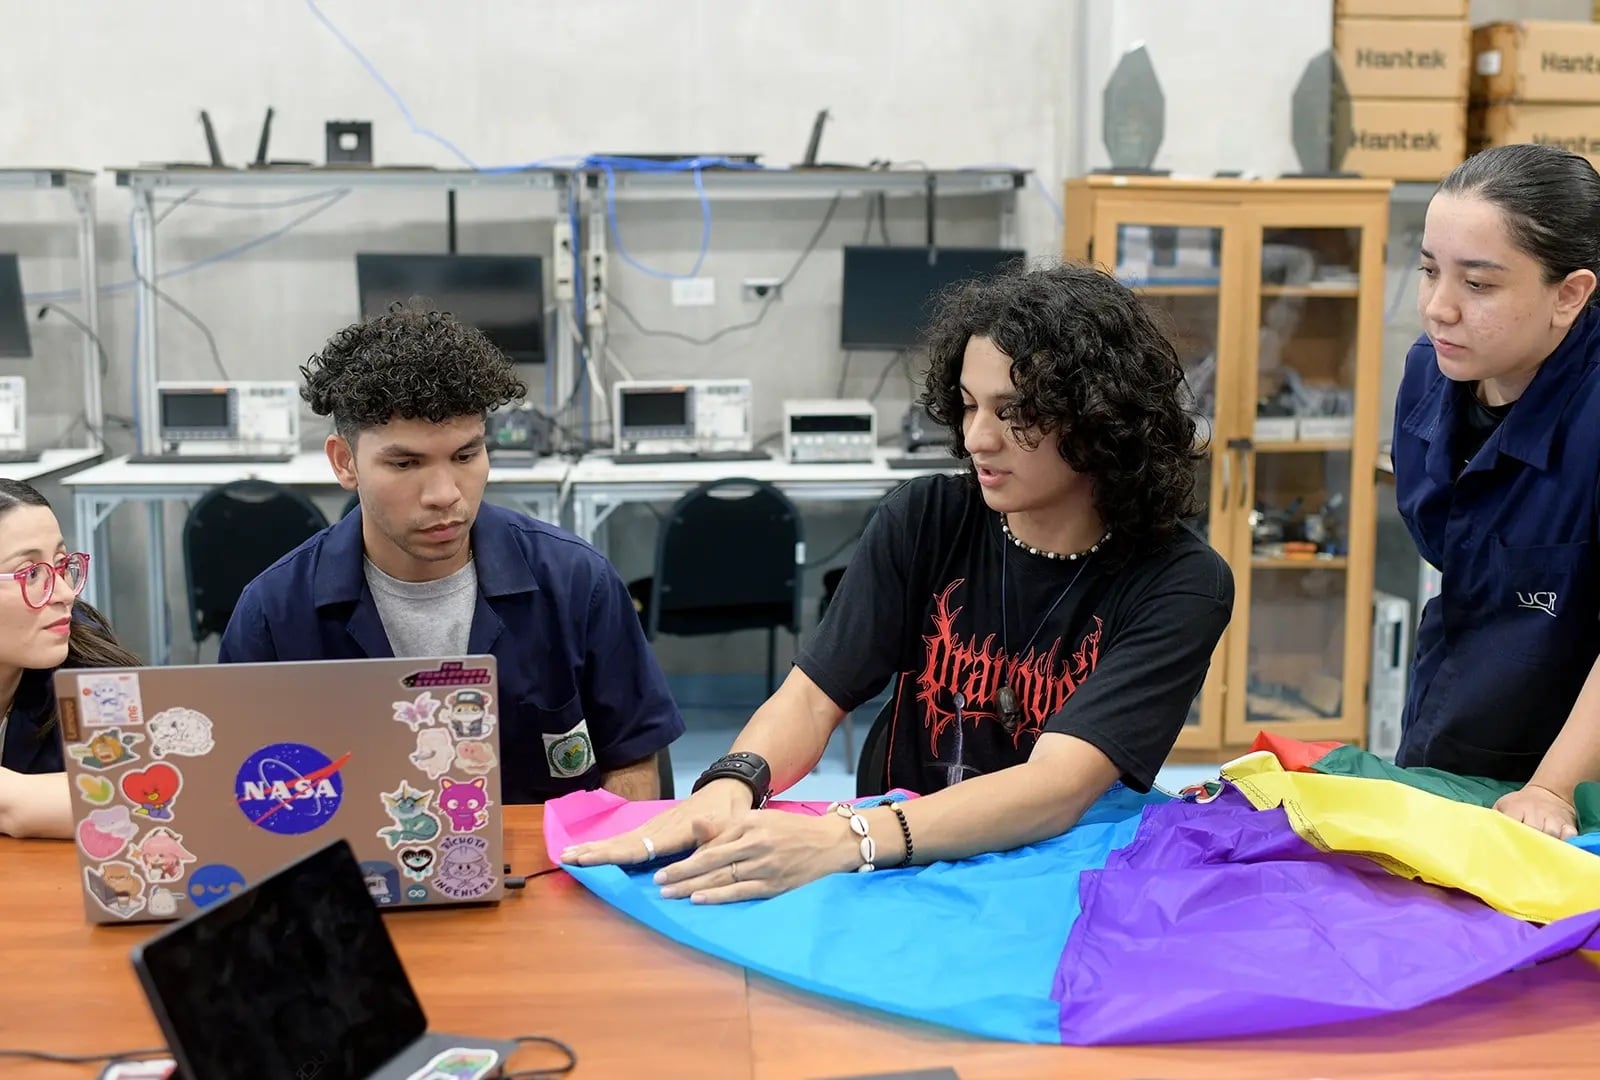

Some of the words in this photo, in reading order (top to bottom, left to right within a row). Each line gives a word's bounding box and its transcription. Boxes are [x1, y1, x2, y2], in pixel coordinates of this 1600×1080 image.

[1355, 48, 1448, 70] Hantek
[1541, 51, 1600, 74] Hant
[1516, 591, 1557, 612] UCR
[243, 779, 338, 801] NASA
